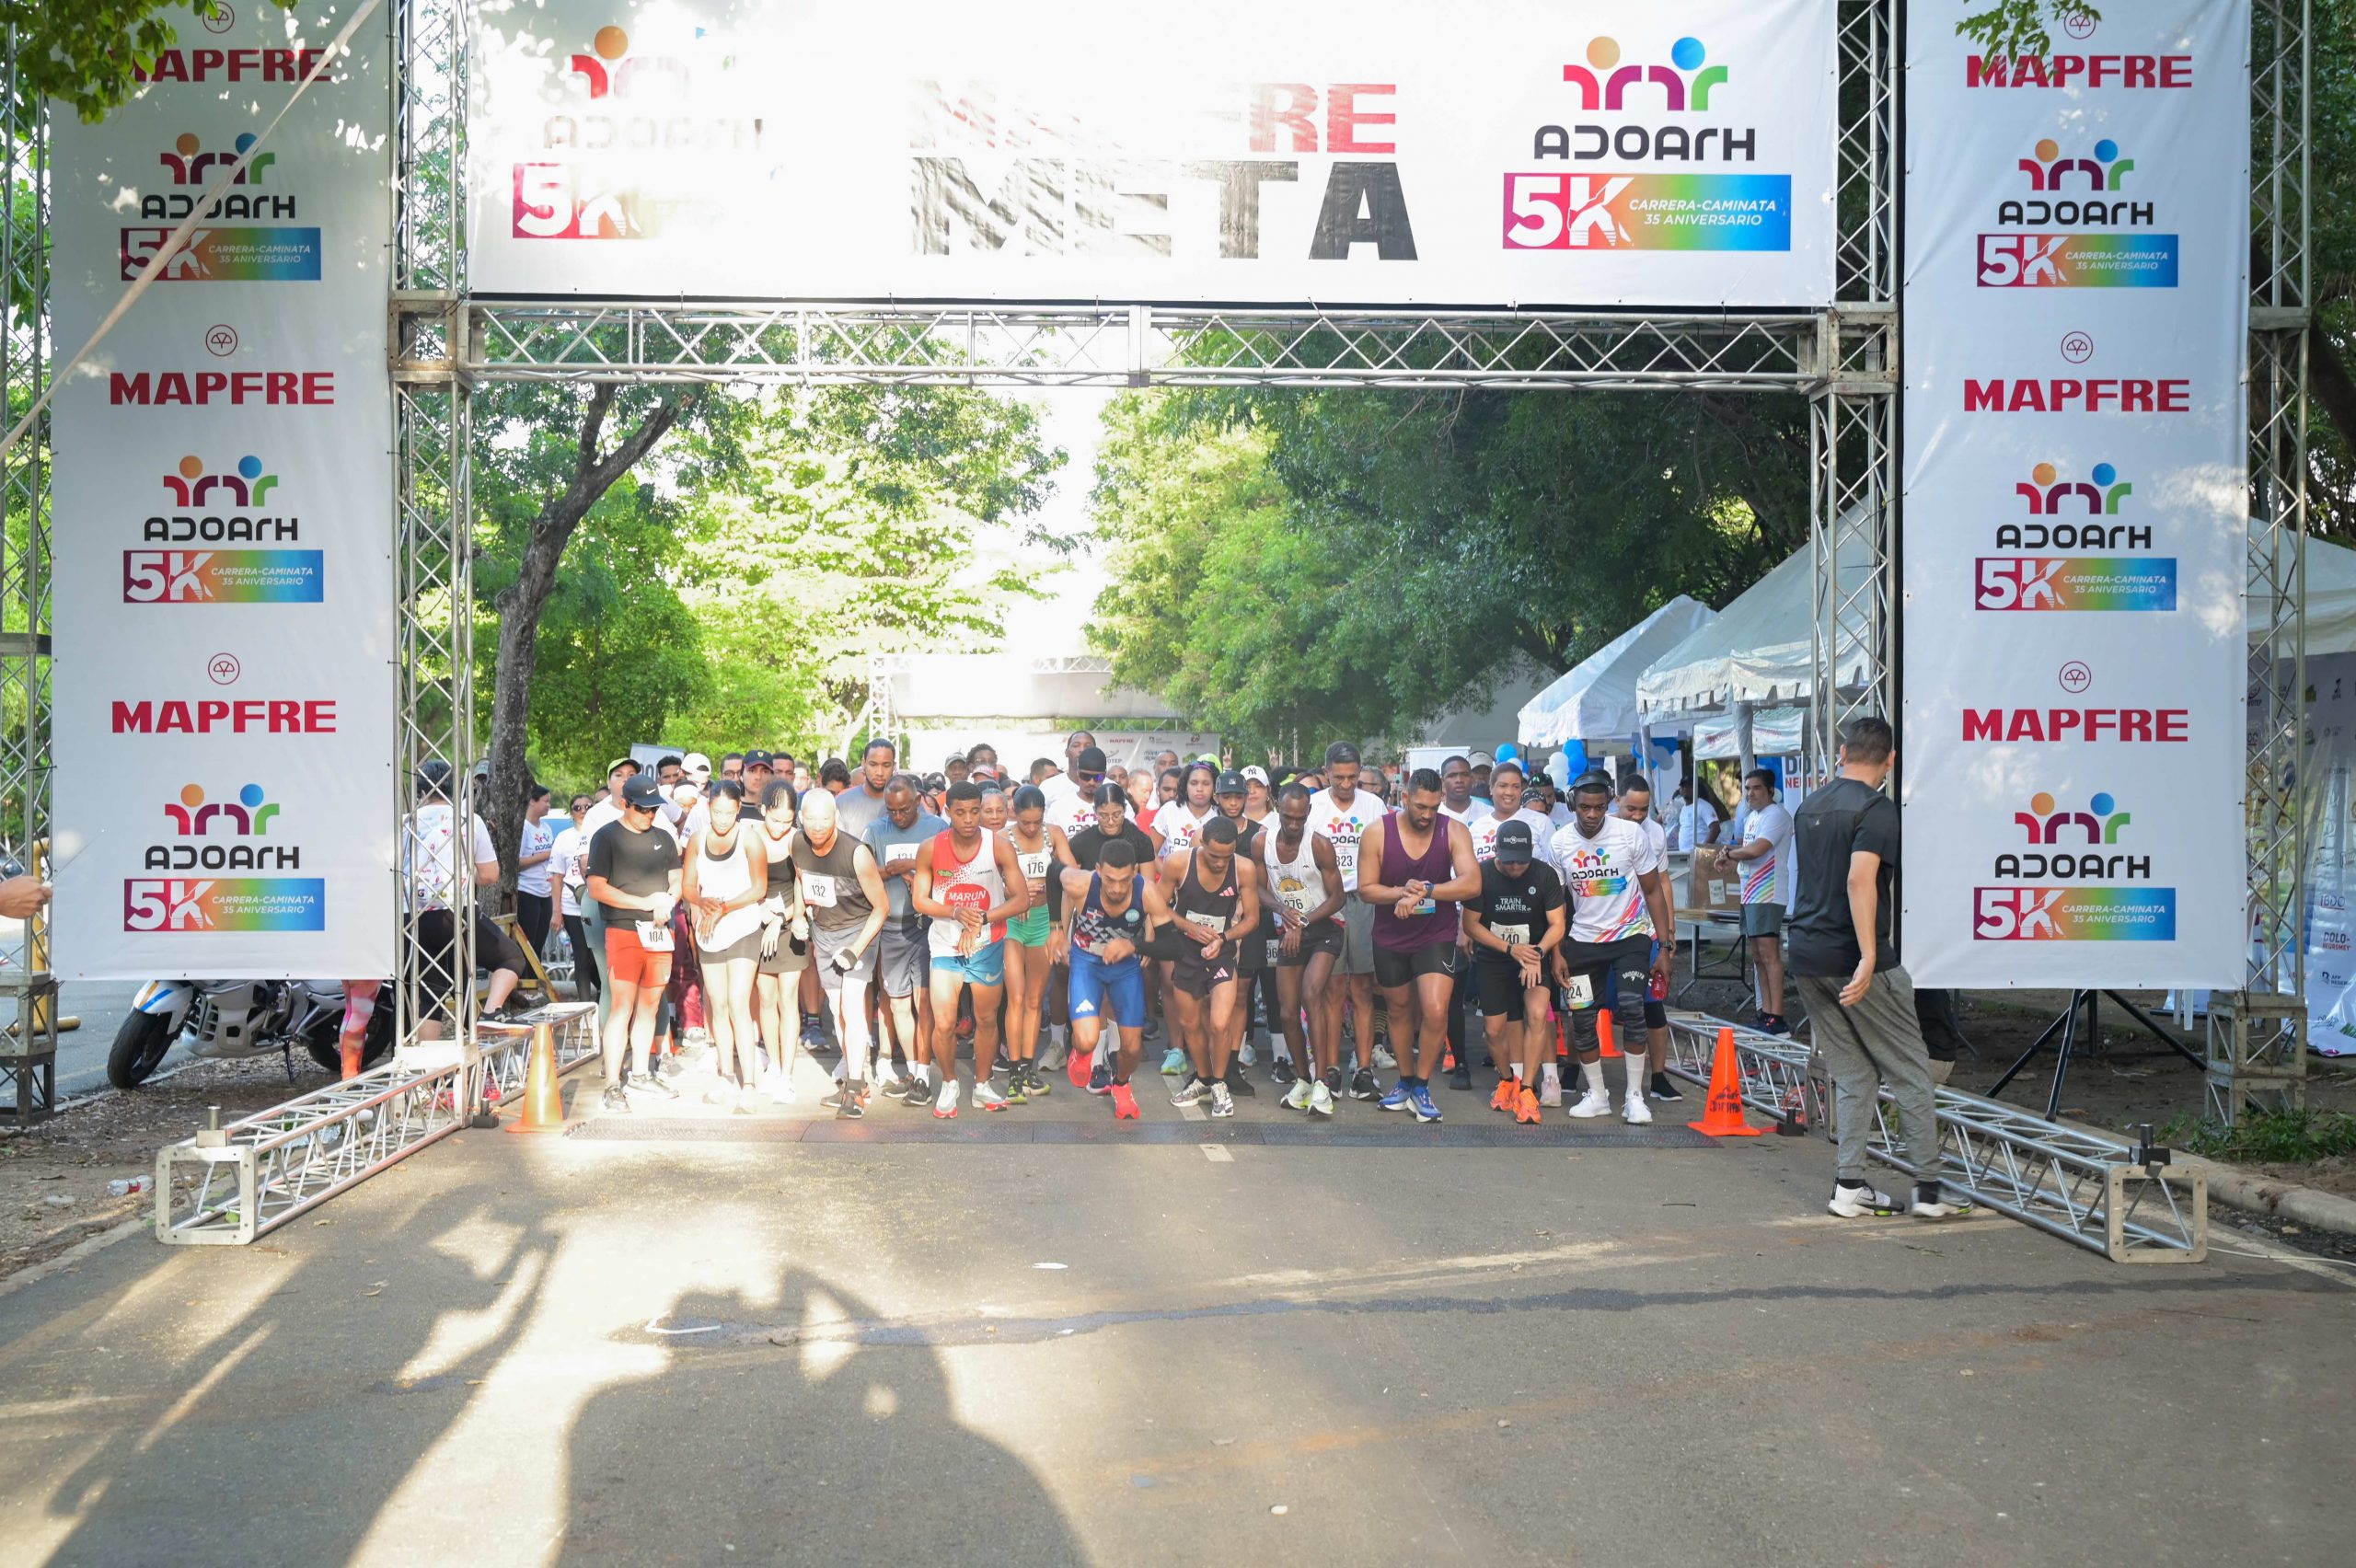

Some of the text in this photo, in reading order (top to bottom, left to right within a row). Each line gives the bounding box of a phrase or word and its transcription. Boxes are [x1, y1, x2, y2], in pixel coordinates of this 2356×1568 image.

[108, 49, 332, 82] APFRE
[1967, 55, 2192, 88] MAPFRE
[1534, 125, 1755, 161] ADOARH
[1507, 176, 1635, 248] 5K
[1629, 199, 1776, 212] CARRERA-CAMINATA
[1644, 214, 1761, 226] 35 ANIVERSARIO
[1998, 201, 2154, 225] ADOARH
[208, 244, 311, 254] CARRERA-CAMINATA
[2065, 251, 2168, 260] CARRERA-CAMINATA
[218, 255, 302, 264] 35 ANIVERSARIO
[1981, 236, 2069, 285] 5K
[2075, 261, 2158, 271] 35 ANIVERSARIO
[110, 372, 334, 405] MAPFRE
[1964, 379, 2189, 412] MAPFRE
[144, 517, 298, 541] ADOARH
[1996, 525, 2152, 549] ADOARH
[127, 552, 214, 602] 5K
[211, 567, 314, 576] CARRERA-CAMINATA
[222, 577, 304, 586] 35 ANIVERSARIO
[1978, 559, 2067, 609] 5K
[2063, 575, 2166, 584] CARRERA-CAMINATA
[2073, 585, 2156, 594] 35 ANIVERSARIO
[112, 700, 336, 733] MAPFRE
[1962, 709, 2189, 742] MAPFRE
[145, 845, 299, 870] ADOARH
[1027, 861, 1044, 874] 176
[1995, 854, 2150, 879] ADOARH
[811, 884, 826, 898] 132
[948, 890, 986, 902] MARUN
[127, 881, 215, 930] 5K
[213, 895, 315, 905] CARRERA-CAMINATA
[223, 905, 305, 915] 35 ANIVERSARIO
[1976, 889, 2065, 939] 5K
[2062, 905, 2165, 914] CARRERA-CAMINATA
[2073, 915, 2155, 924] 35 ANIVERSARIO
[649, 930, 664, 942] 104
[1501, 933, 1519, 945] 140
